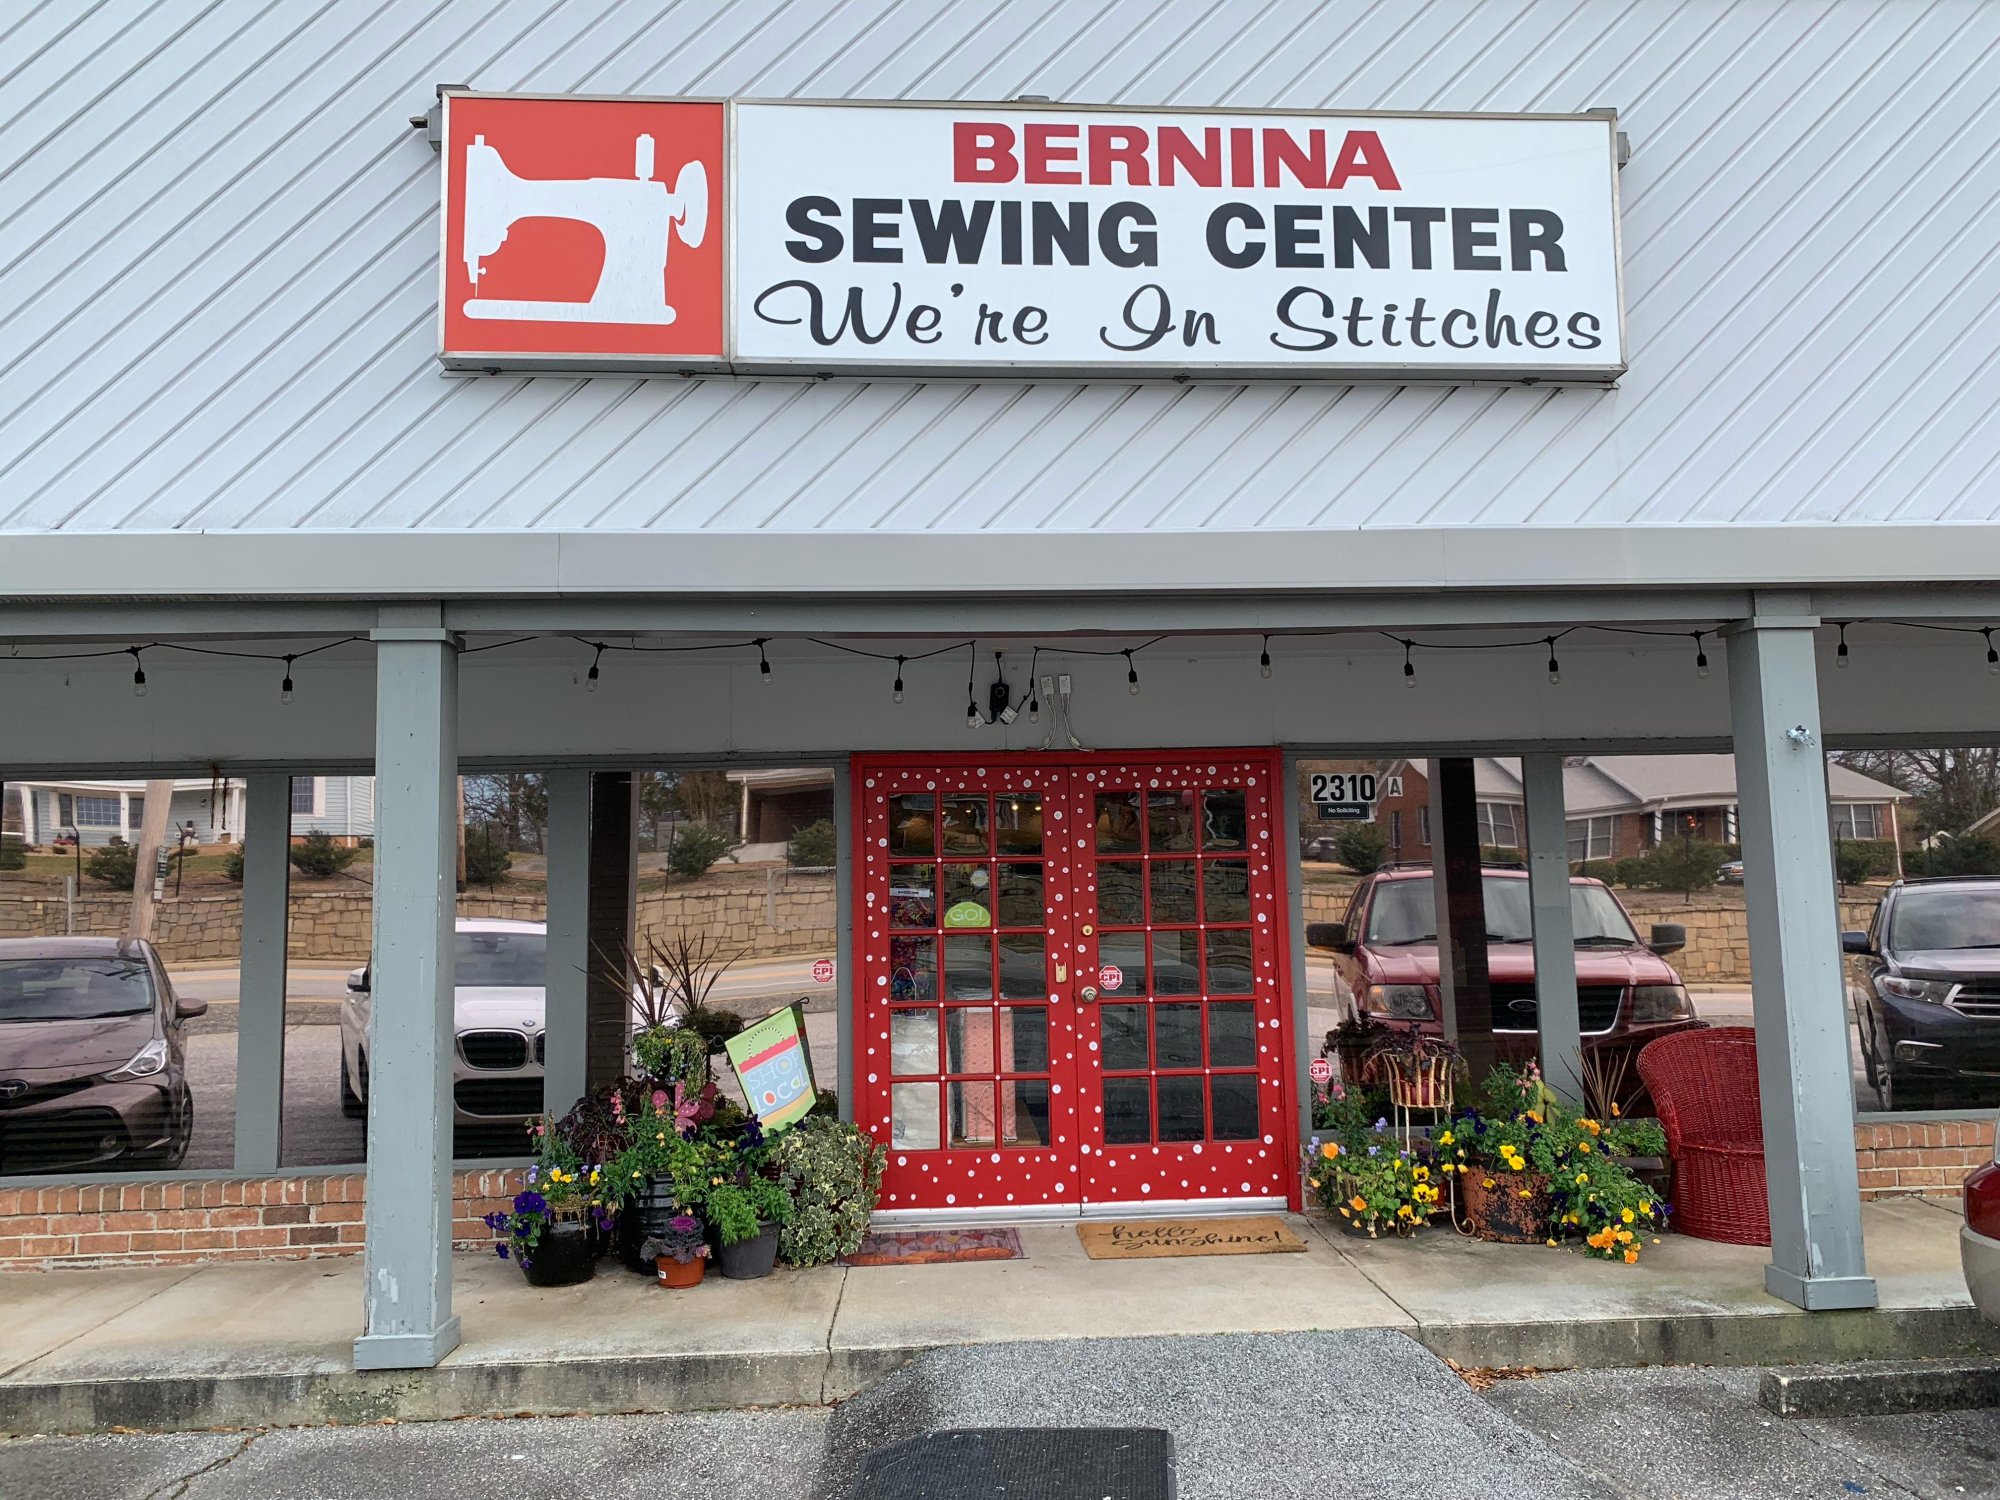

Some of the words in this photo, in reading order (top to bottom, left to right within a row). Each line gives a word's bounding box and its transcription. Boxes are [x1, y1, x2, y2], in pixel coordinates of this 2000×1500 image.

[953, 122, 1402, 190] BERNINA
[785, 195, 1158, 268] SEWING
[1205, 202, 1568, 272] CENTER
[754, 280, 1048, 345] We're
[1100, 284, 1221, 352] In
[1270, 286, 1602, 351] Stitches
[1312, 774, 1376, 801] 2310
[1390, 778, 1402, 795] A
[813, 967, 833, 975] CPI
[1101, 973, 1120, 981] CPI
[1310, 1066, 1330, 1075] CPI
